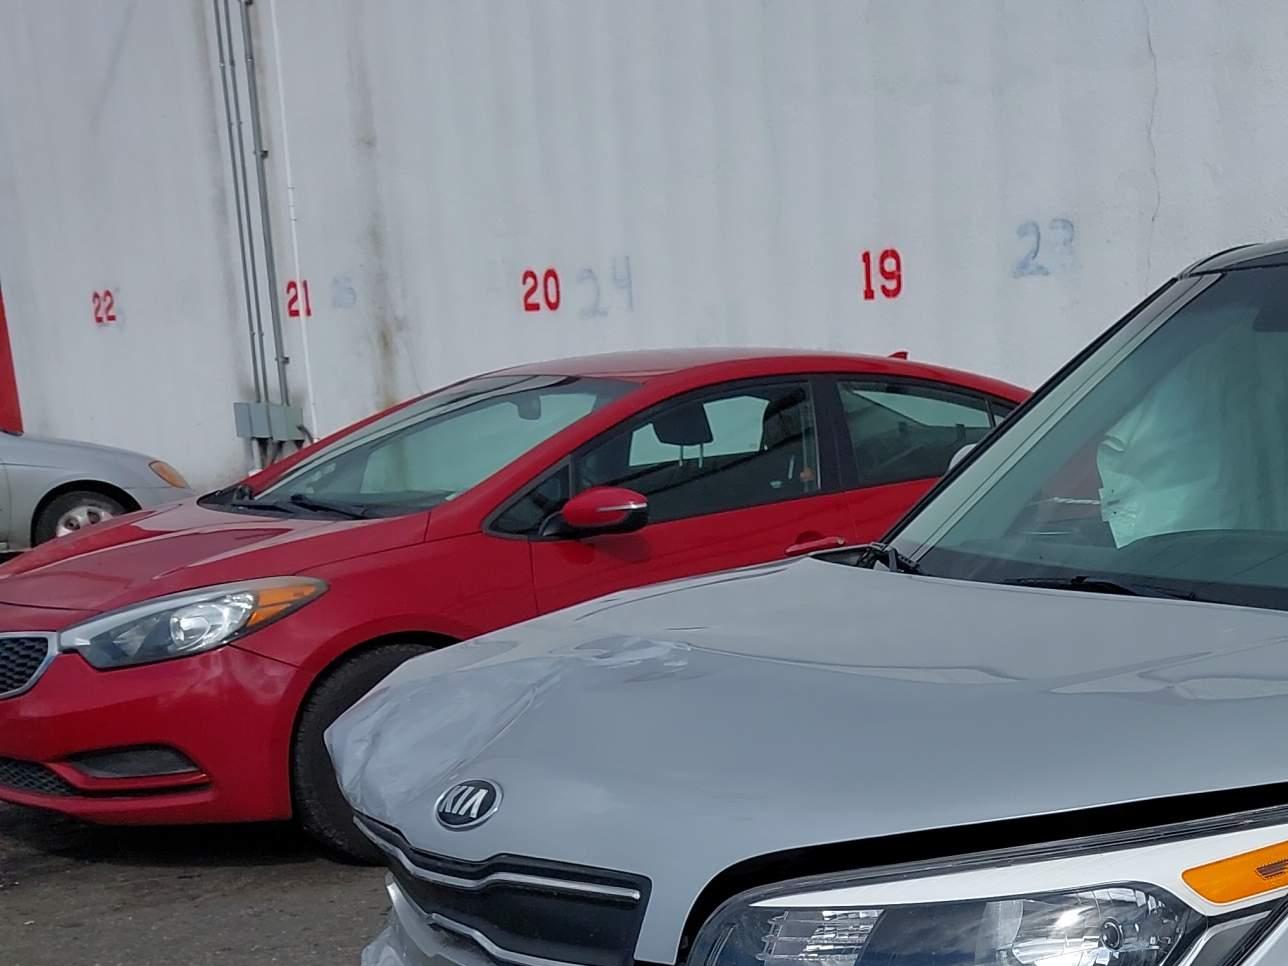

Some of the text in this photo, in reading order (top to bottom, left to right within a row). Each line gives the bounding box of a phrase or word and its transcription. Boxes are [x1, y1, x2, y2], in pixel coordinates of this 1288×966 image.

[522, 268, 560, 311] 20
[861, 248, 902, 300] 19
[92, 289, 116, 323] 22
[286, 280, 312, 317] 21
[439, 785, 489, 819] KIA
